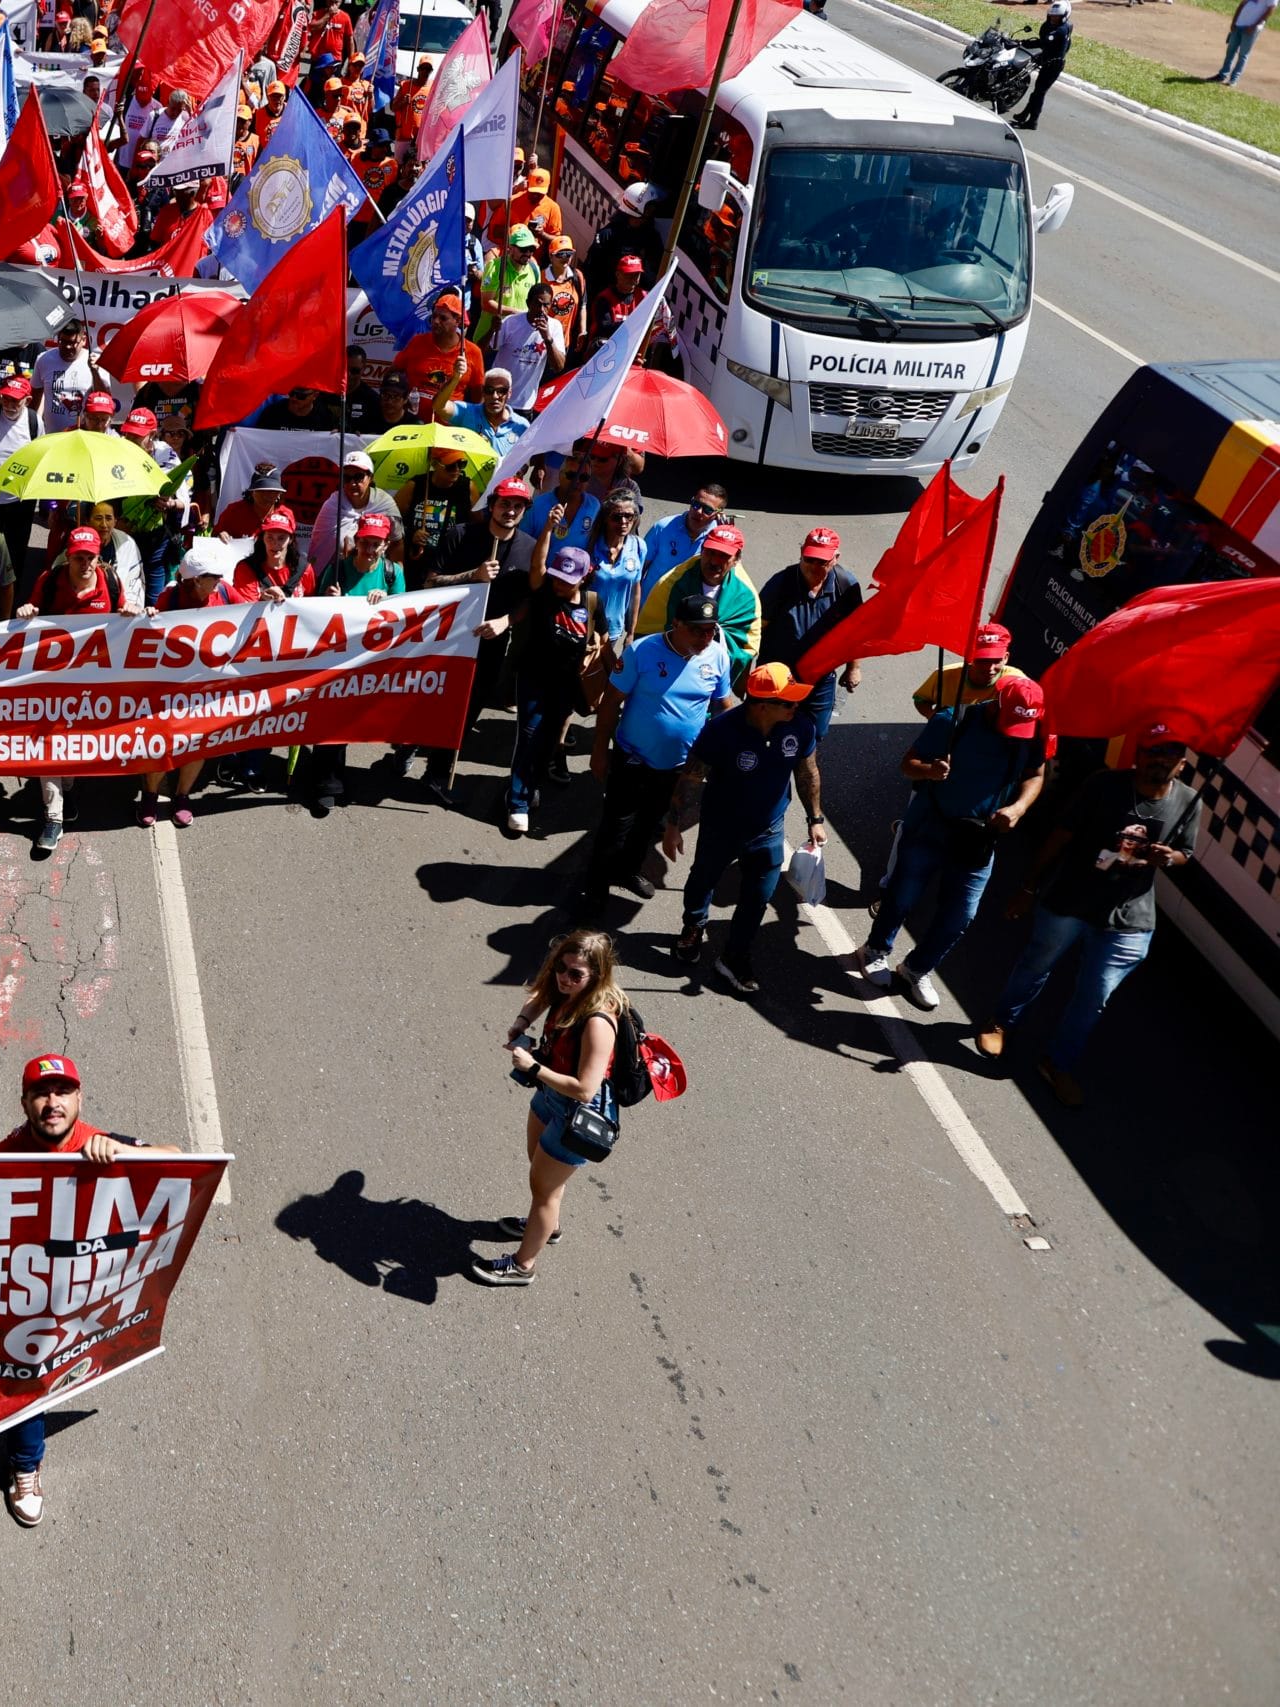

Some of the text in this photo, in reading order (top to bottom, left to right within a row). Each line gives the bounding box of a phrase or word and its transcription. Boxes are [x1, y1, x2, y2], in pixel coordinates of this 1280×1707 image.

[139, 363, 172, 376] CUT
[809, 353, 967, 380] POLÍCIA MILITAR
[609, 424, 649, 443] CUT
[9, 463, 28, 475] CUT
[1045, 590, 1070, 617] DISTRITO
[1048, 577, 1075, 607] POLÍCIA
[32, 628, 113, 672] DA
[123, 613, 348, 669] ESCALA
[361, 601, 462, 652] 6X1
[119, 696, 153, 720] DA
[158, 689, 272, 720] JORNADA
[284, 687, 316, 708] DE
[319, 670, 448, 700] TRABALHO!
[51, 727, 167, 767] REDUÇÃO
[172, 734, 205, 760] DE
[208, 710, 308, 748] SALÁRIO!
[76, 1238, 108, 1256] DA
[3, 1278, 145, 1365] 6X1
[52, 1309, 150, 1370] ESCRAVIDÃO!
